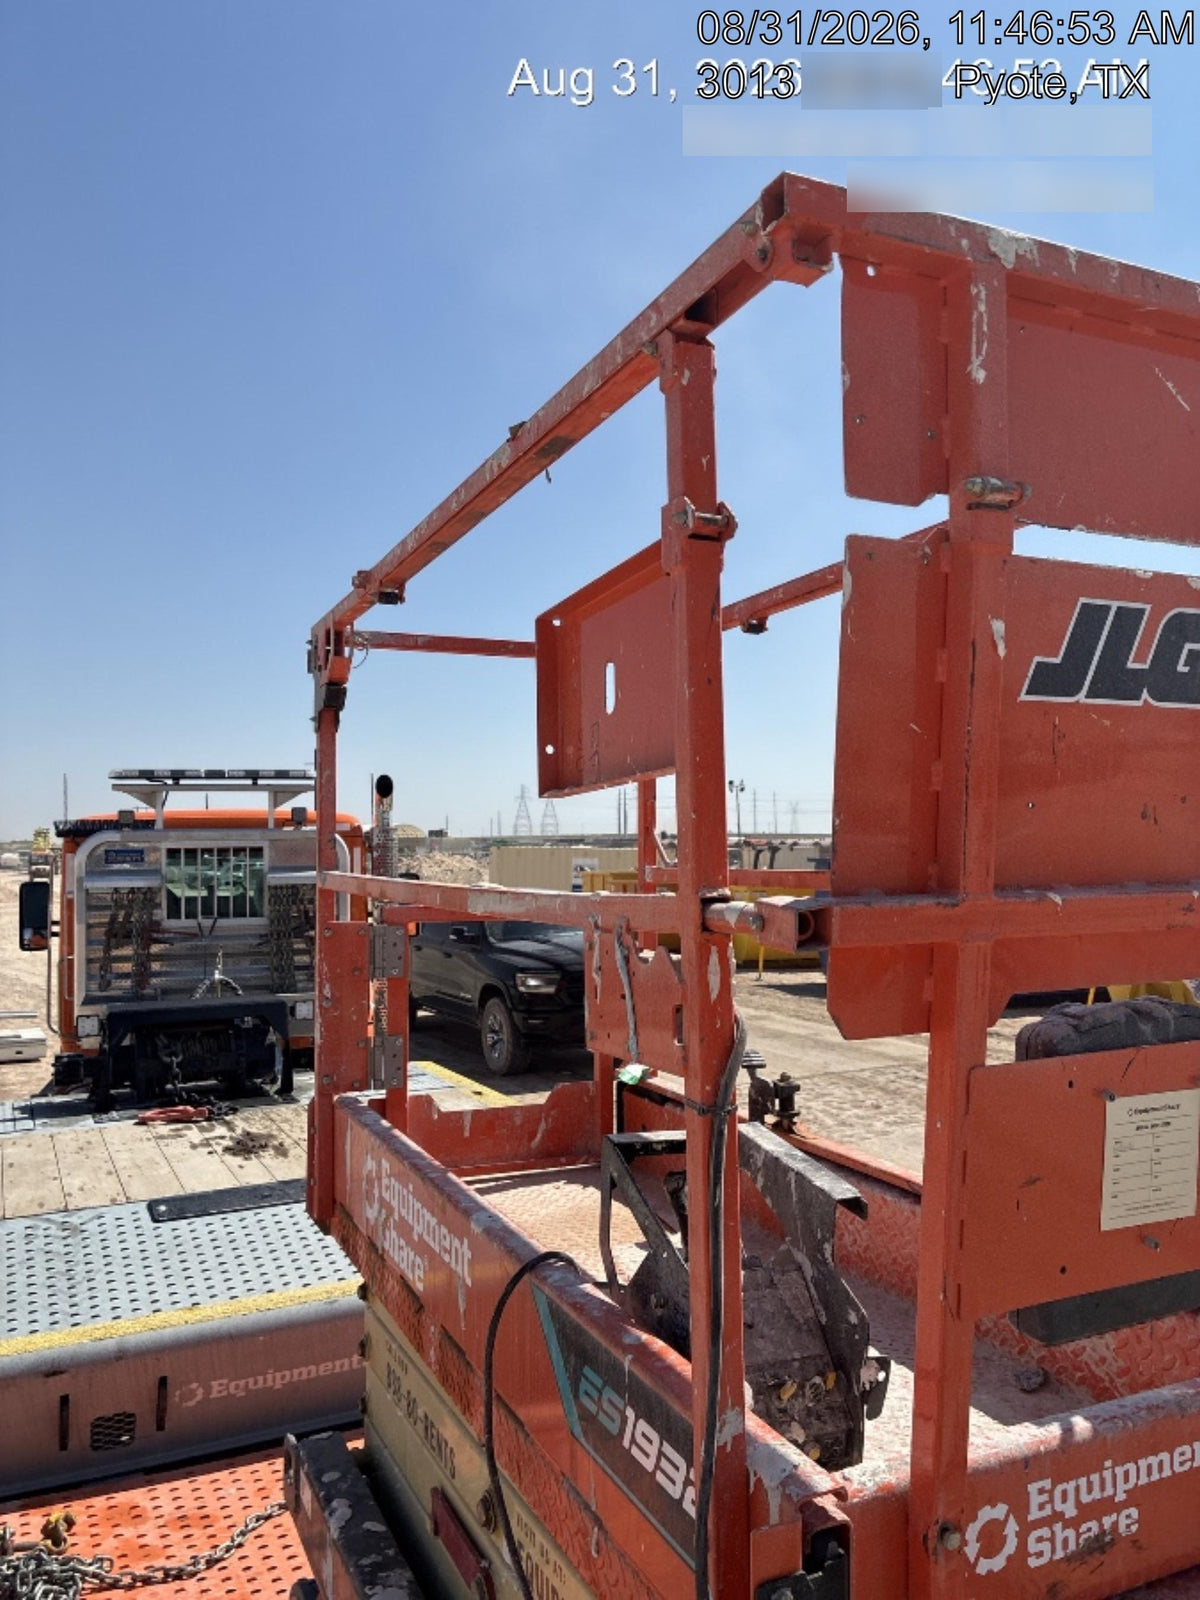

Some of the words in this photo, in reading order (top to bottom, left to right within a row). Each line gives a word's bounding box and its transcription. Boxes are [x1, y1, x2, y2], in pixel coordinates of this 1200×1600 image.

[1017, 597, 1200, 710] JLG
[381, 1157, 472, 1288] Equipment
[209, 1353, 369, 1398] Equipment
[1027, 1507, 1139, 1568] Share
